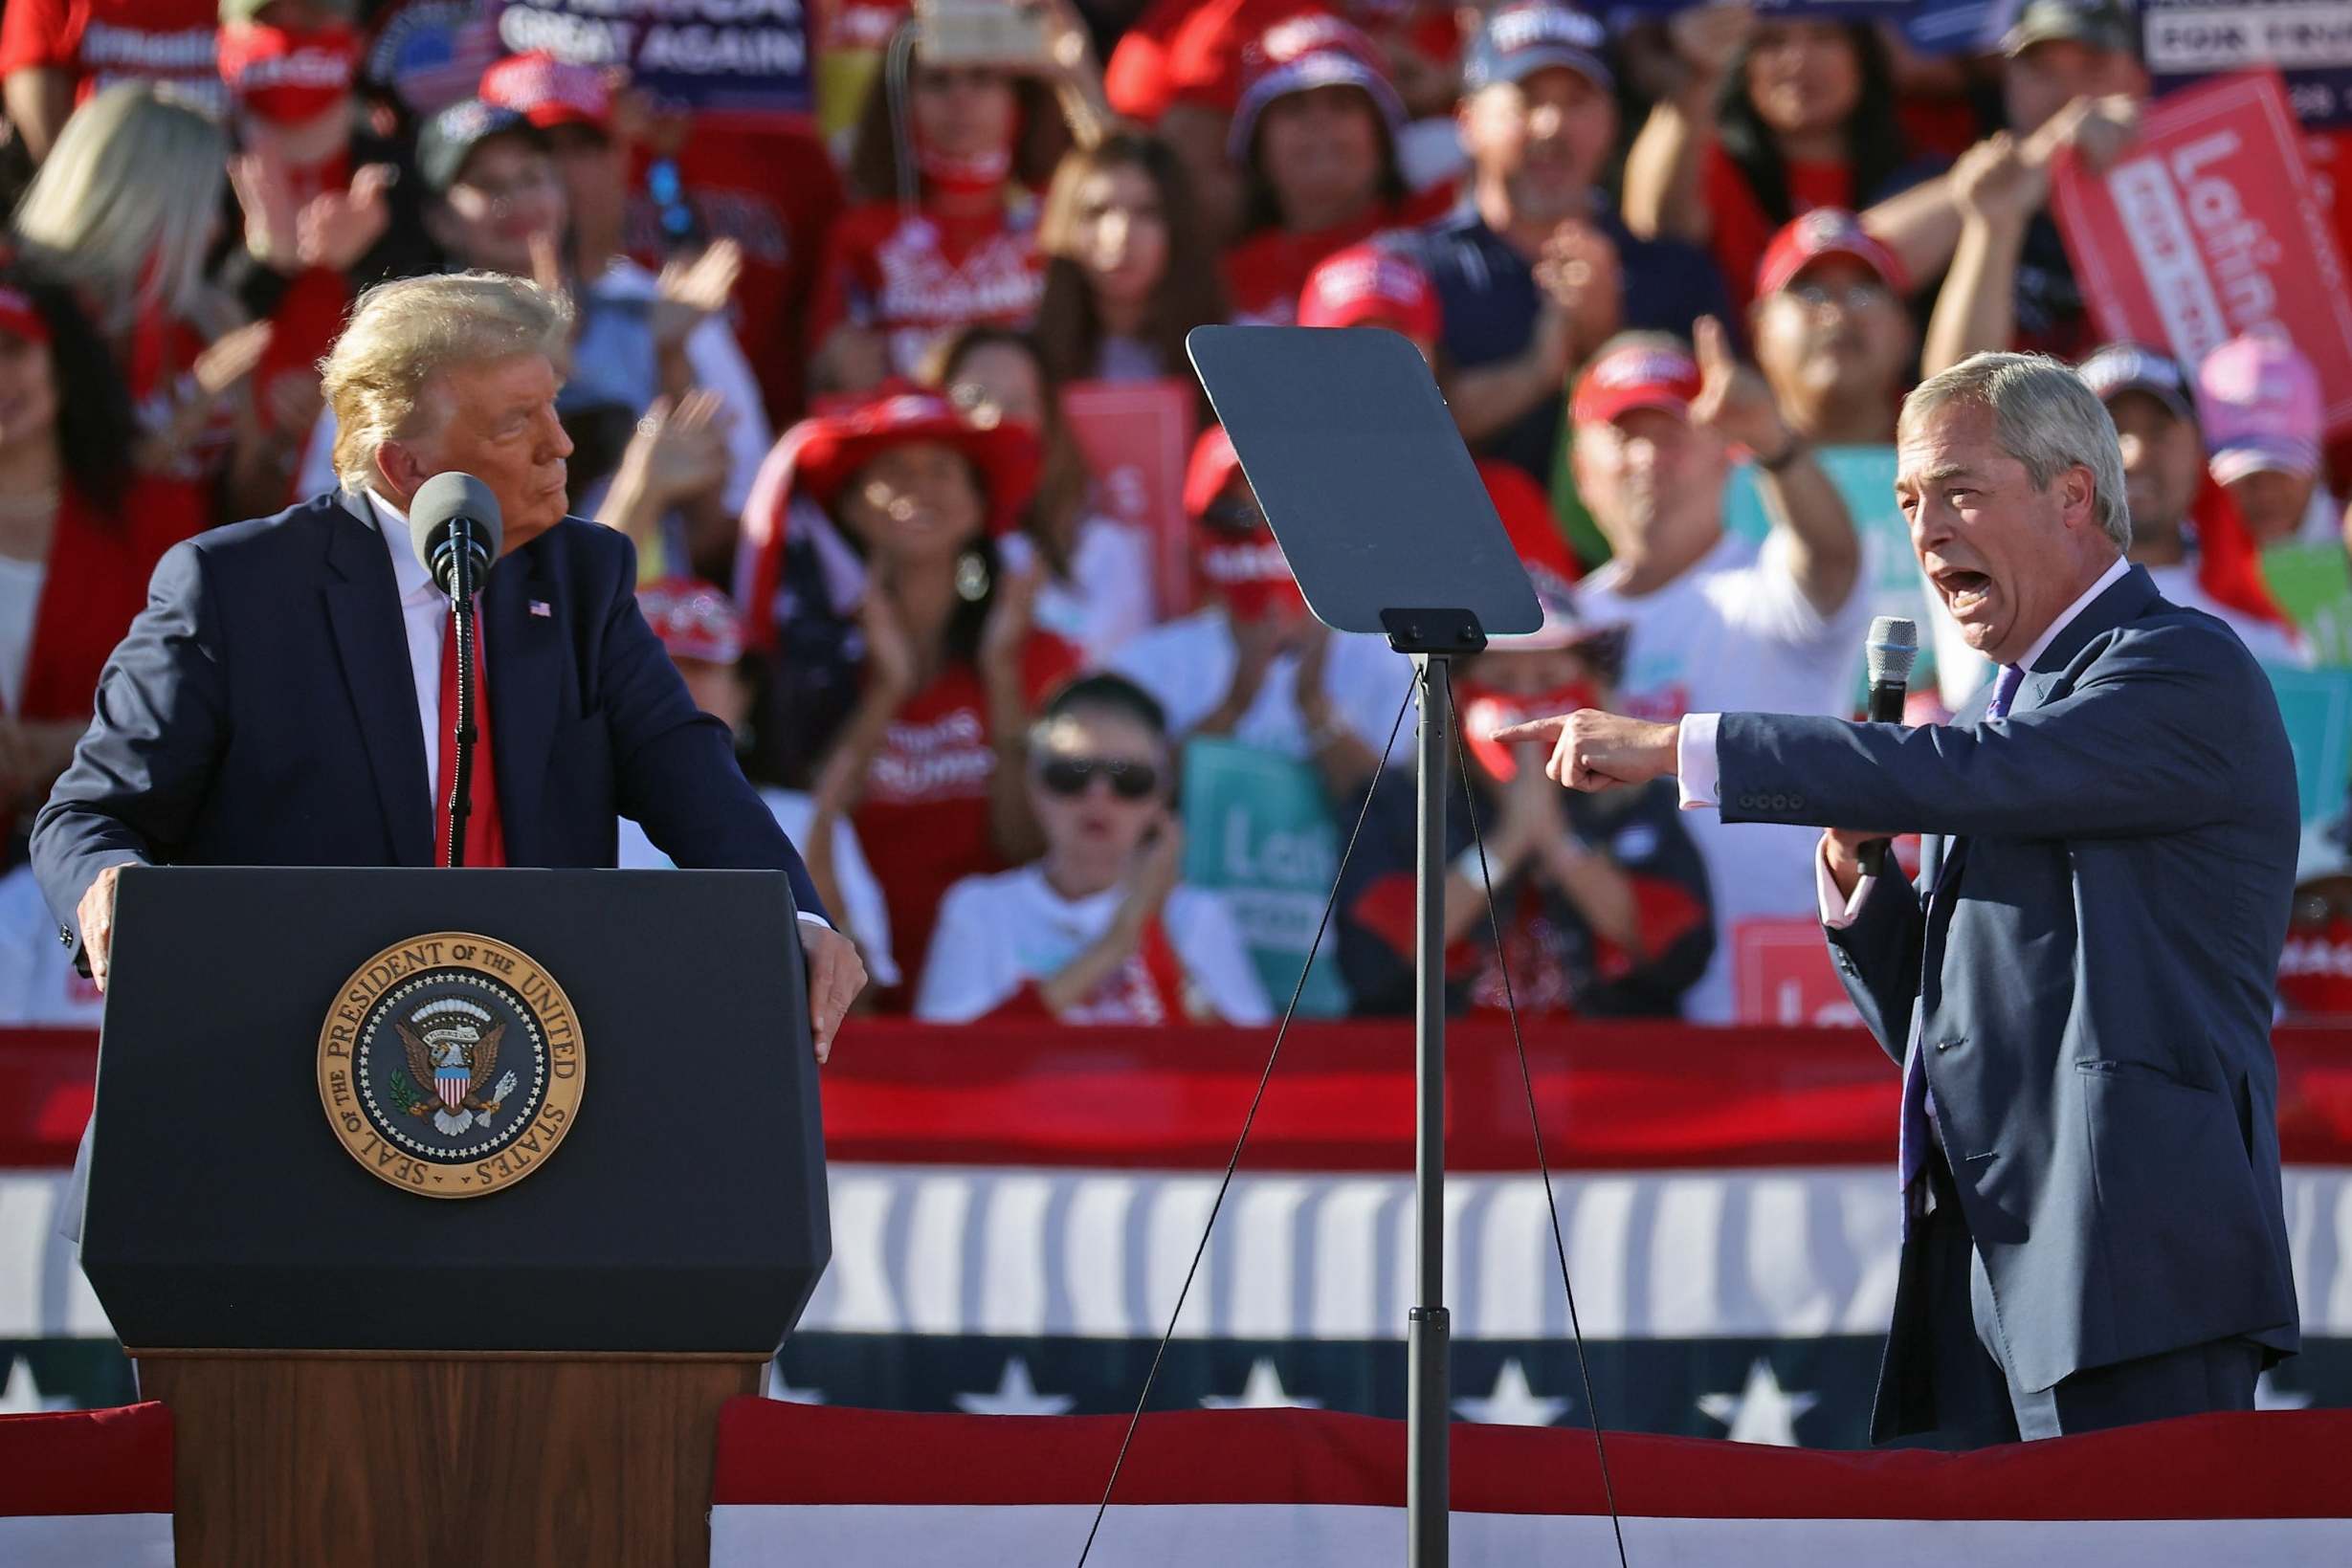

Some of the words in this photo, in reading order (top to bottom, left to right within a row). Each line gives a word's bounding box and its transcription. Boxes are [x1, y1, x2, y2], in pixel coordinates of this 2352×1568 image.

[638, 23, 806, 76] AGAIN
[452, 944, 477, 961] OF
[482, 949, 516, 975] THE
[327, 941, 444, 1059] PRESIDENT
[520, 973, 577, 1079] UNITED
[331, 1070, 351, 1106] THE
[342, 1110, 362, 1133] OF
[476, 1103, 566, 1185] STATES
[361, 1129, 429, 1185] SEAL
